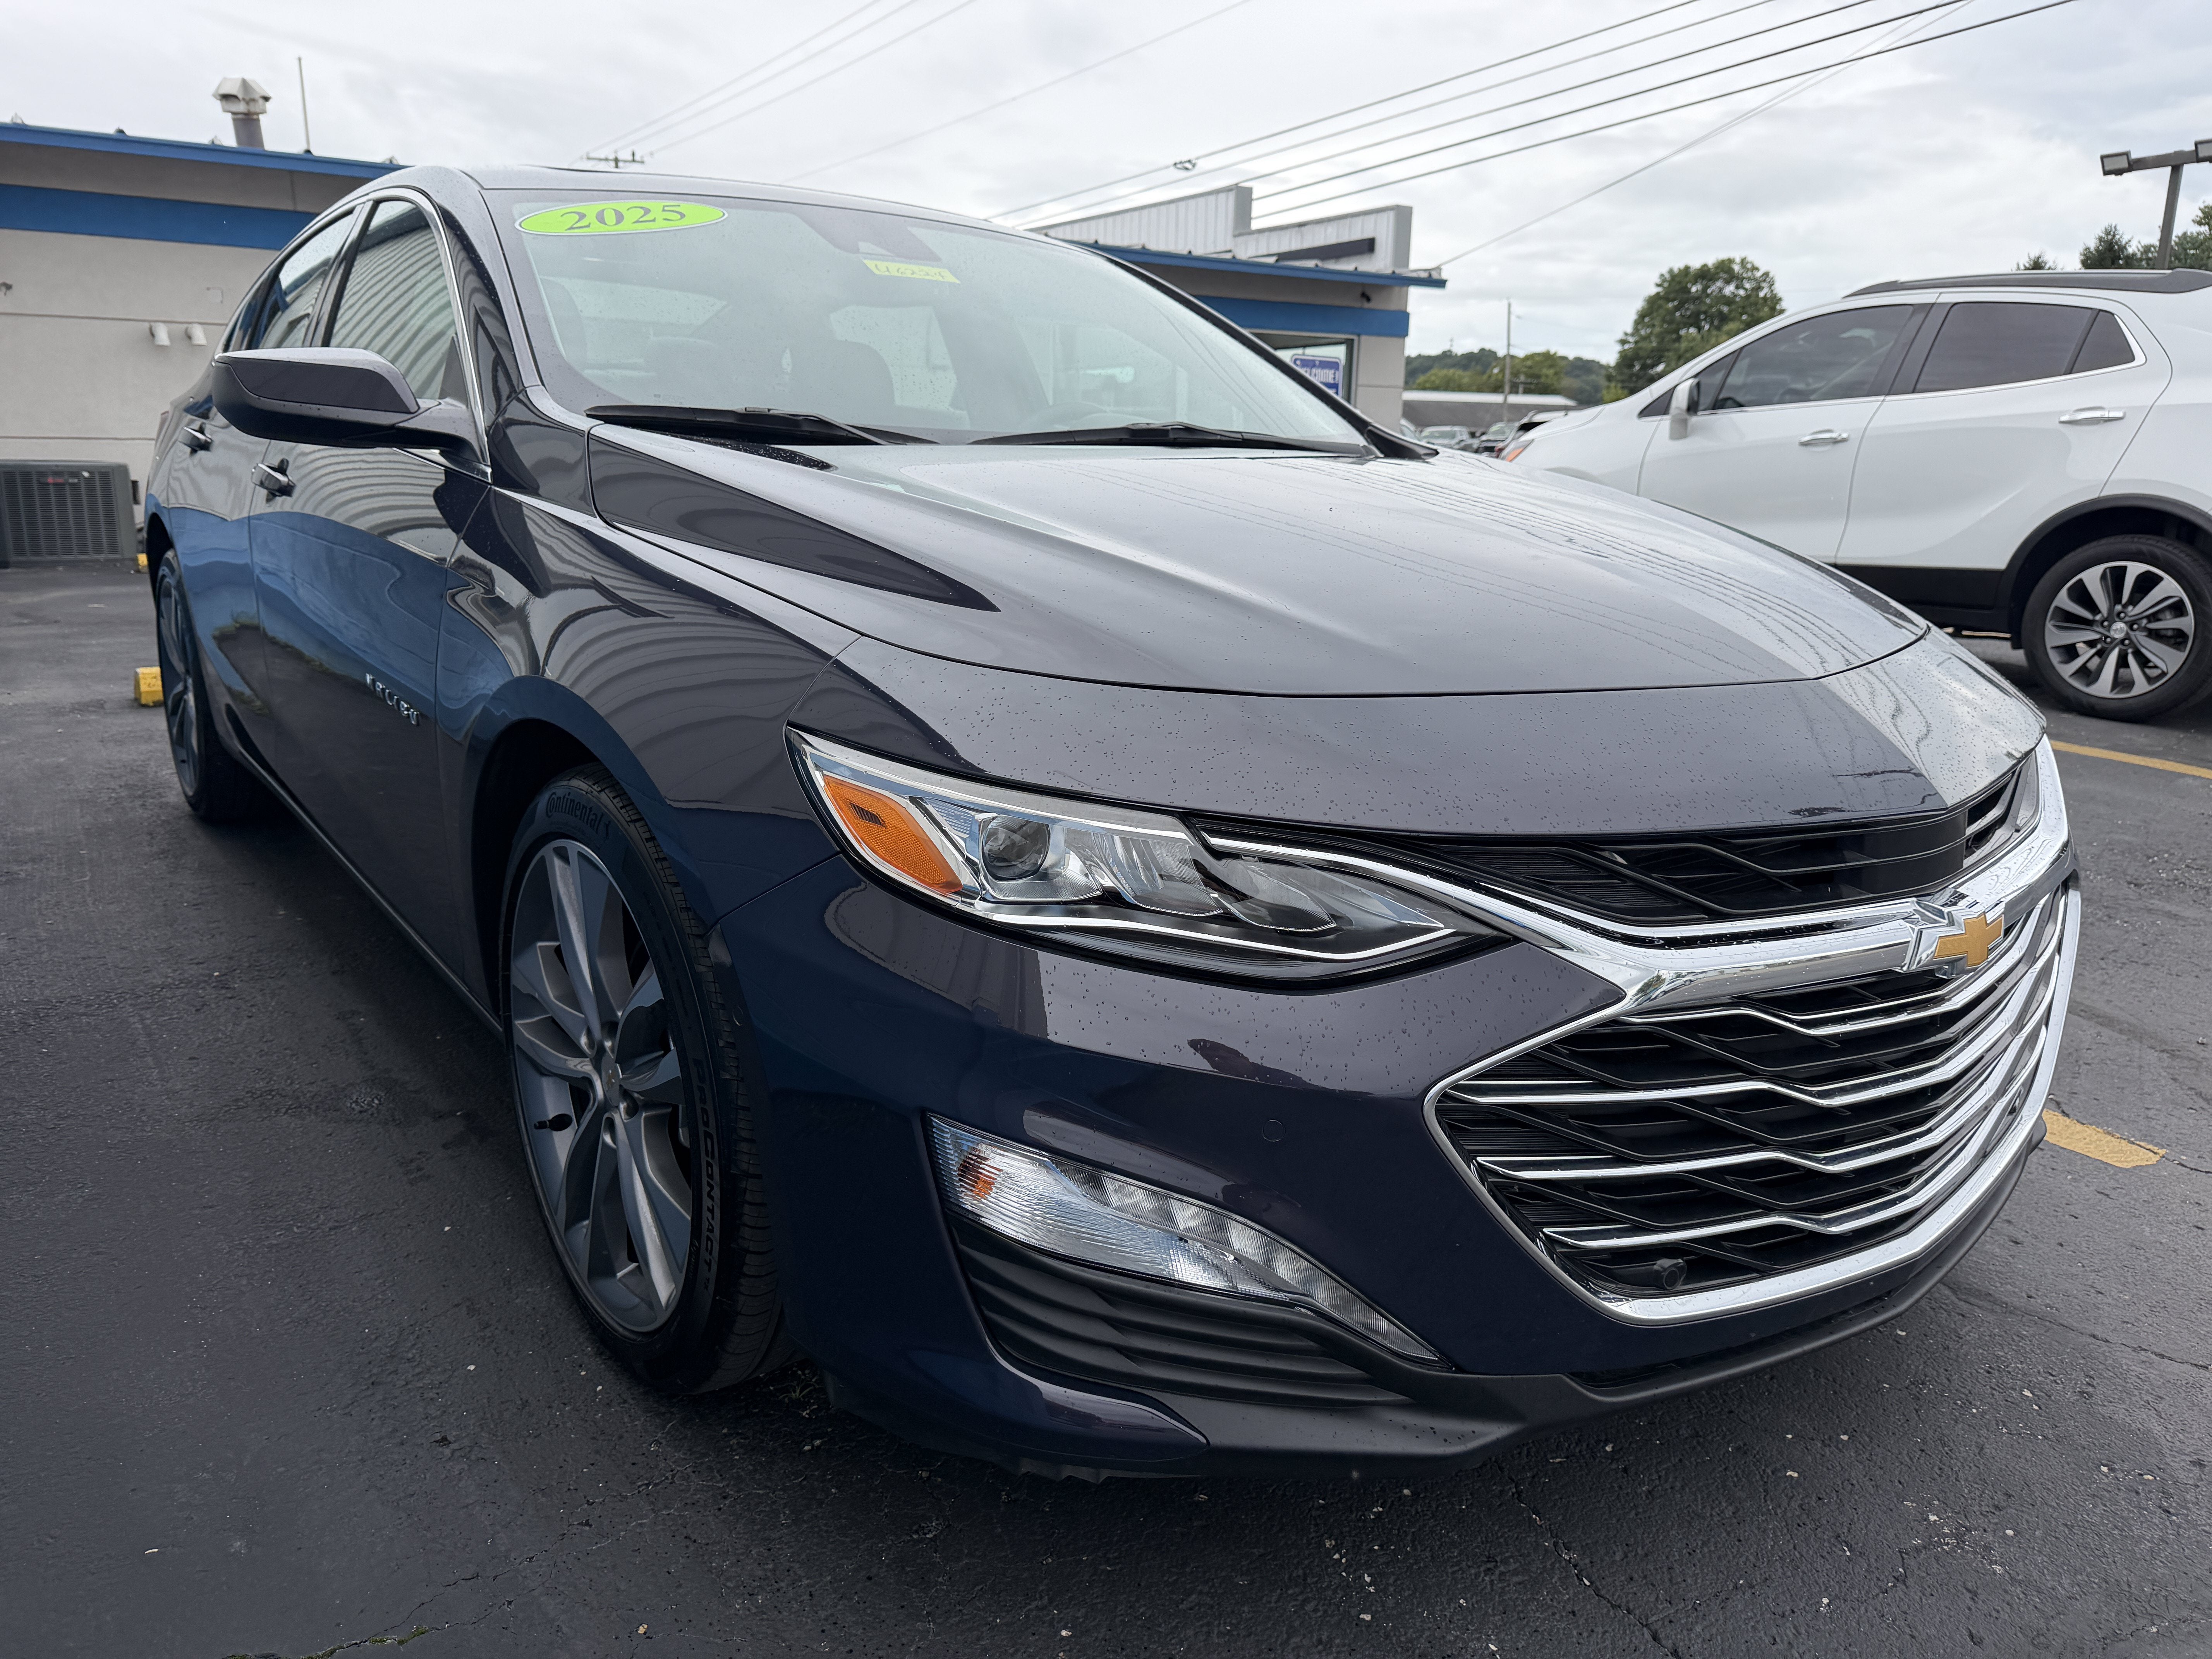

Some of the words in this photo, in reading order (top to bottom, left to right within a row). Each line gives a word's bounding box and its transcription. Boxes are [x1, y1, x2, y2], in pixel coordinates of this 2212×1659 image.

[561, 204, 685, 230] 2025
[1300, 368, 1339, 383] LCOME!
[546, 792, 604, 834] Continental
